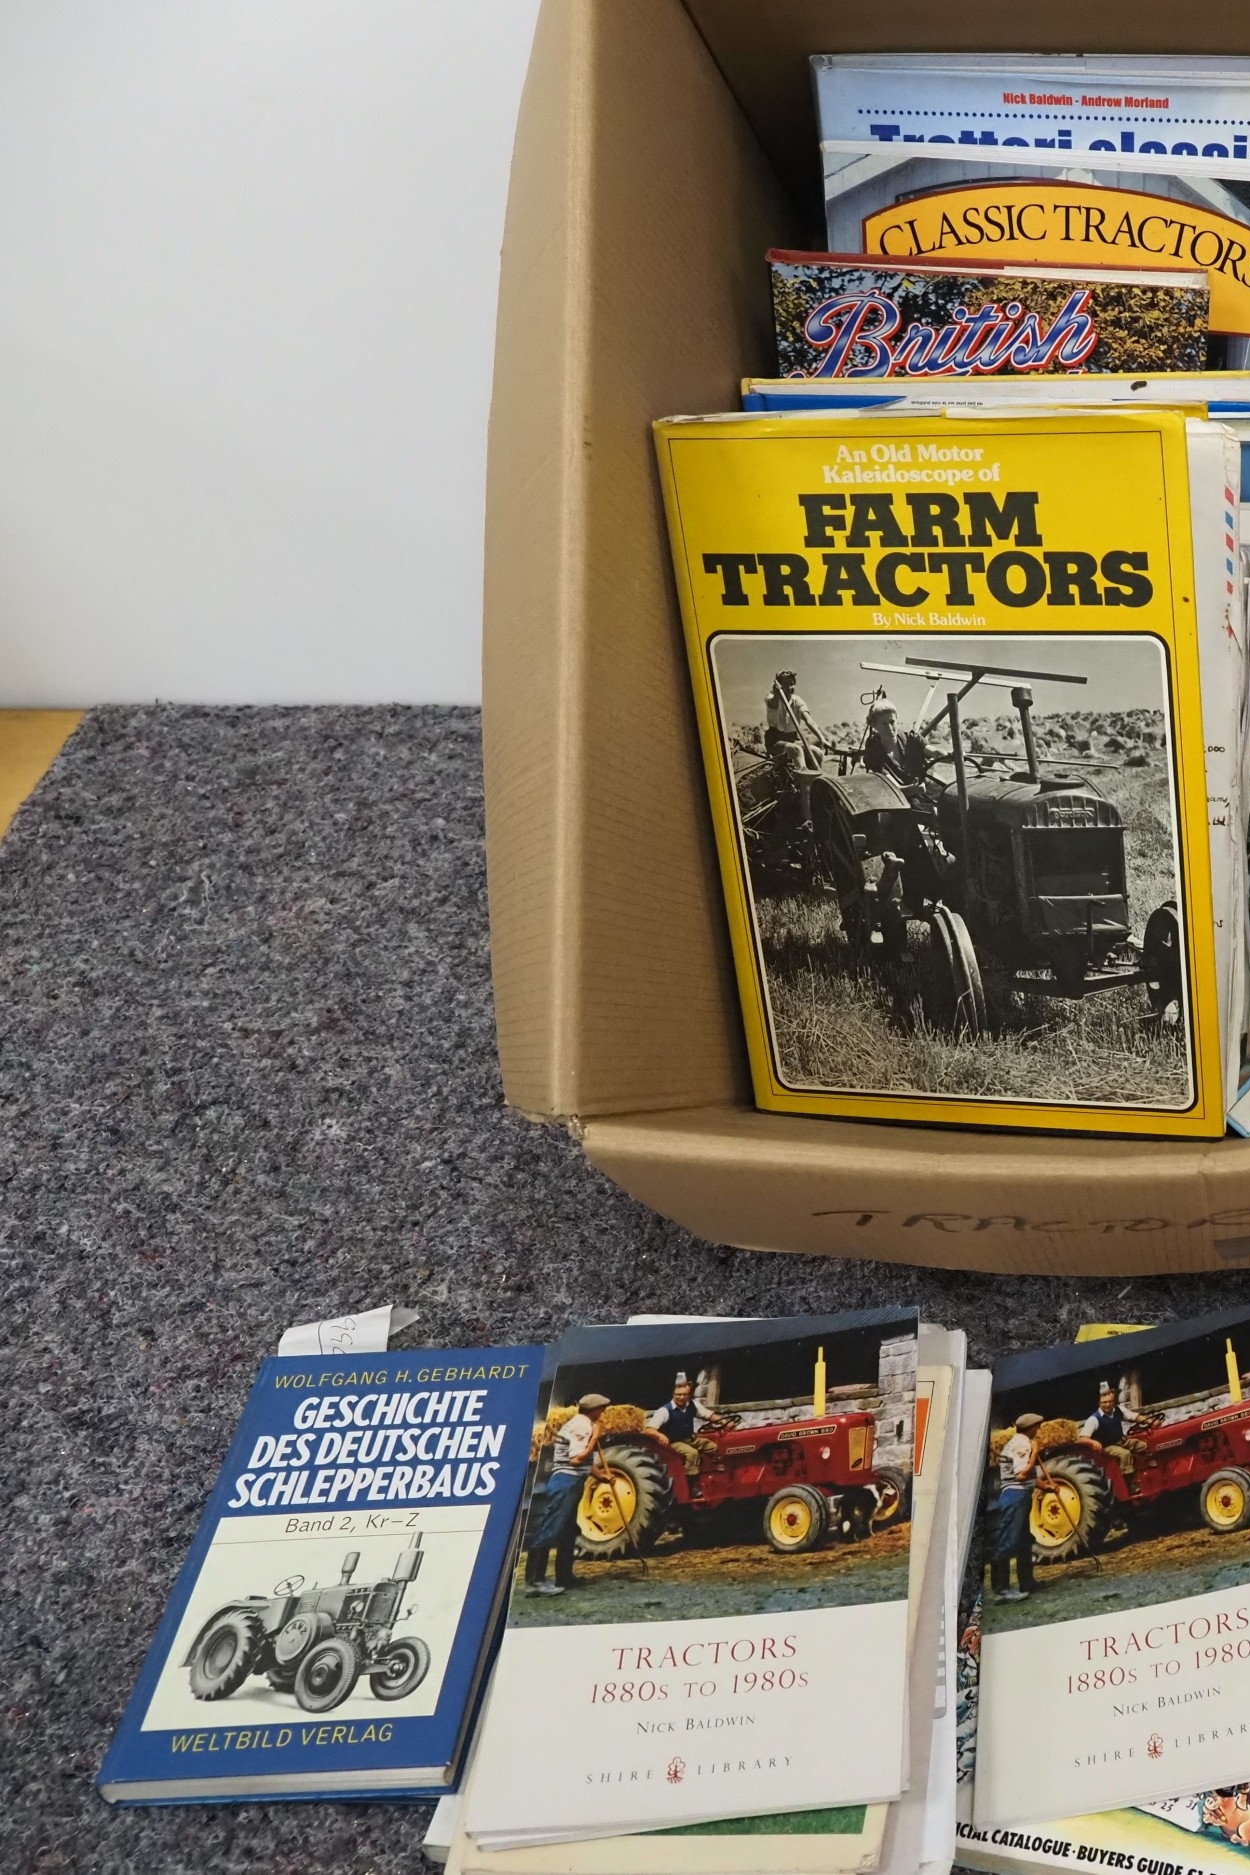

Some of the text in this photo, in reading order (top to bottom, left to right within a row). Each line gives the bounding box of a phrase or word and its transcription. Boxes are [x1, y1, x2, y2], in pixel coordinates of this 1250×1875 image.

[1003, 92, 1027, 105] Nick
[1028, 93, 1073, 106] Baldwin
[1081, 95, 1123, 108] Andrew
[1124, 96, 1169, 109] Morland
[879, 203, 1048, 256] CLASSIC
[790, 289, 1098, 377] British
[836, 444, 984, 463] An Old Motor
[822, 463, 1000, 486] Kaleidoscope of
[798, 491, 1043, 548] FARM
[702, 550, 1154, 608] TRACTORS
[873, 612, 986, 628] By Nick Baldwin
[274, 1371, 388, 1390] WOLFGANG
[293, 1389, 488, 1430] GESCHICHTE
[247, 1424, 507, 1470] DES DEUTSCHEN
[228, 1462, 500, 1509] SCHLEPPERBAUS
[284, 1516, 332, 1534] Band
[339, 1516, 357, 1533] 2,
[1080, 1607, 1250, 1662] TRACTORS
[612, 1635, 797, 1670] TRACTORS
[170, 1724, 394, 1753] WELTBILD VERLAG
[586, 1755, 793, 1786] SHIRE LIBRARY
[1074, 1747, 1135, 1768] SHIRE
[991, 1829, 1072, 1858] CATALOGUE
[1076, 1845, 1135, 1870] BUYERS
[1136, 1857, 1184, 1875] GUIDE
